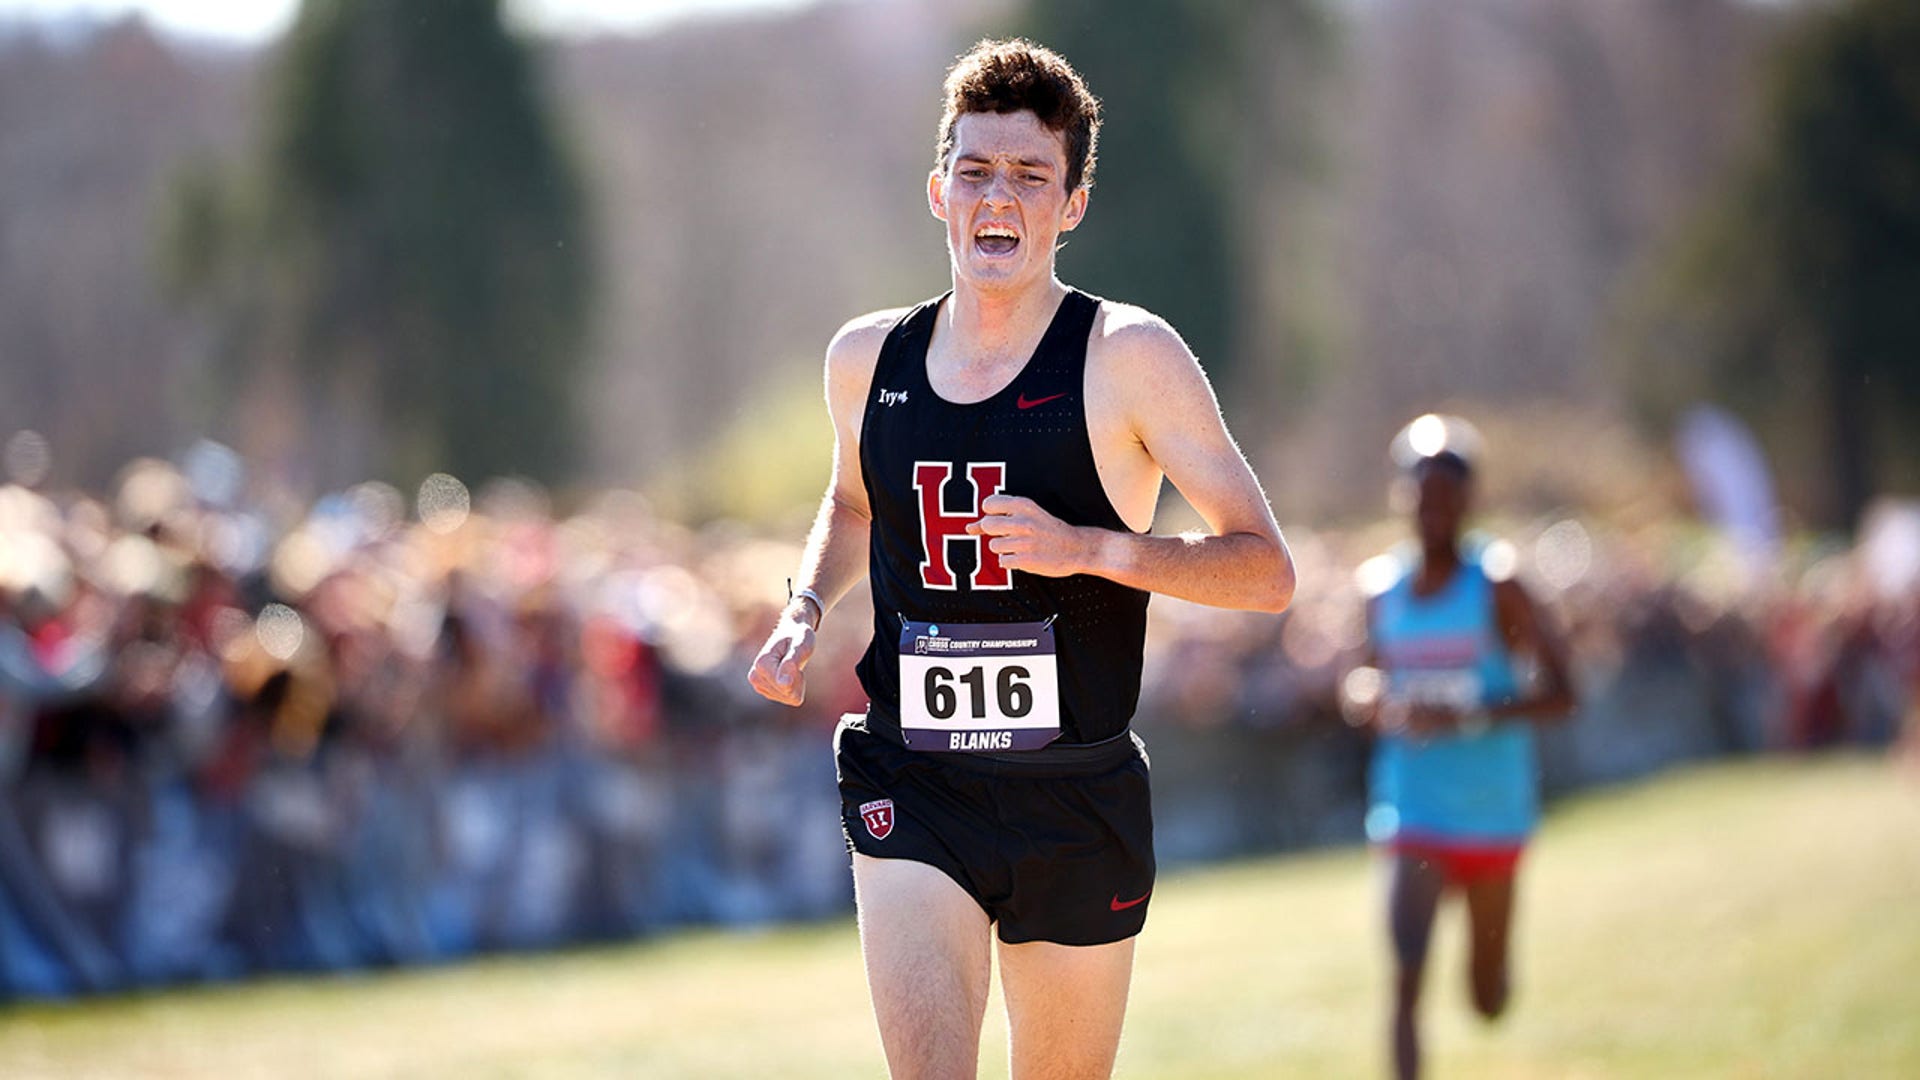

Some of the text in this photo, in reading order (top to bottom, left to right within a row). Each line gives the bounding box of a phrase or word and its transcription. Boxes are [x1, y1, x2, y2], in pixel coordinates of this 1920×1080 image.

[912, 461, 1013, 590] H
[950, 640, 980, 649] COUNTRY
[981, 639, 1037, 649] CHAMPIONSHIPS
[924, 665, 1033, 719] 616
[950, 731, 1012, 750] BLANKS
